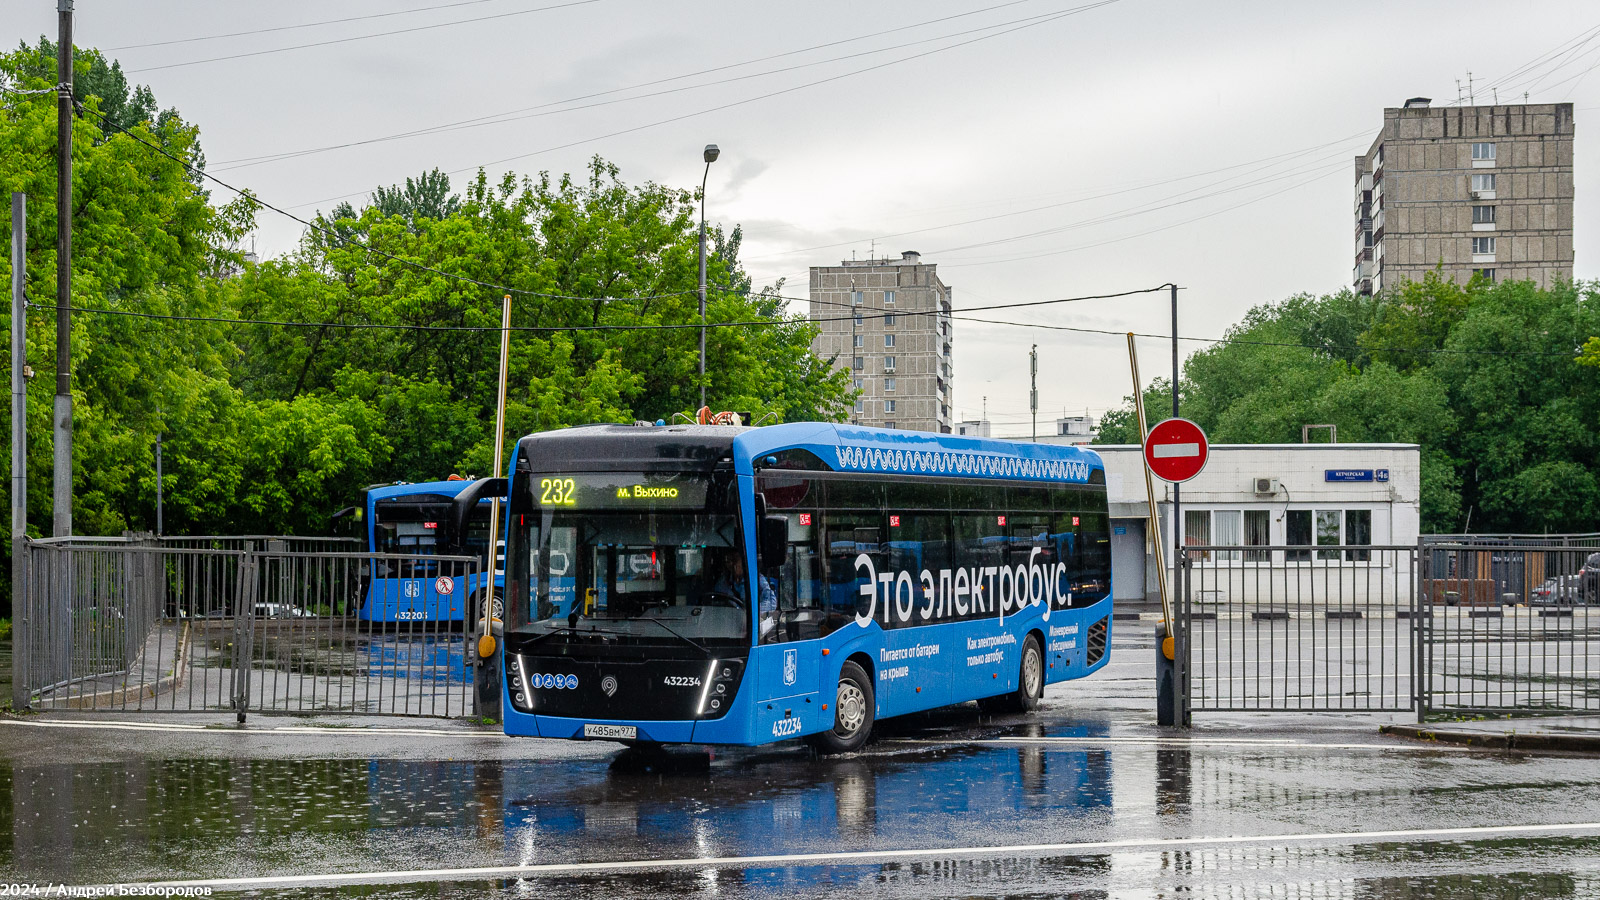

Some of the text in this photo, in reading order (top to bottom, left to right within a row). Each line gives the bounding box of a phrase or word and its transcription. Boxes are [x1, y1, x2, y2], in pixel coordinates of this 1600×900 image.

[540, 478, 678, 504] 232 м. Выхино
[854, 547, 1072, 628] Это электробус.
[1049, 623, 1079, 638] Маневренный
[967, 633, 1017, 651] Как электромобиль,
[1052, 637, 1077, 653] бесшумный
[880, 643, 940, 663] Питается от батареи
[967, 649, 1004, 667] только автобус
[664, 676, 701, 687] 432234
[880, 665, 909, 682] на крыше
[772, 717, 802, 737] 432234
